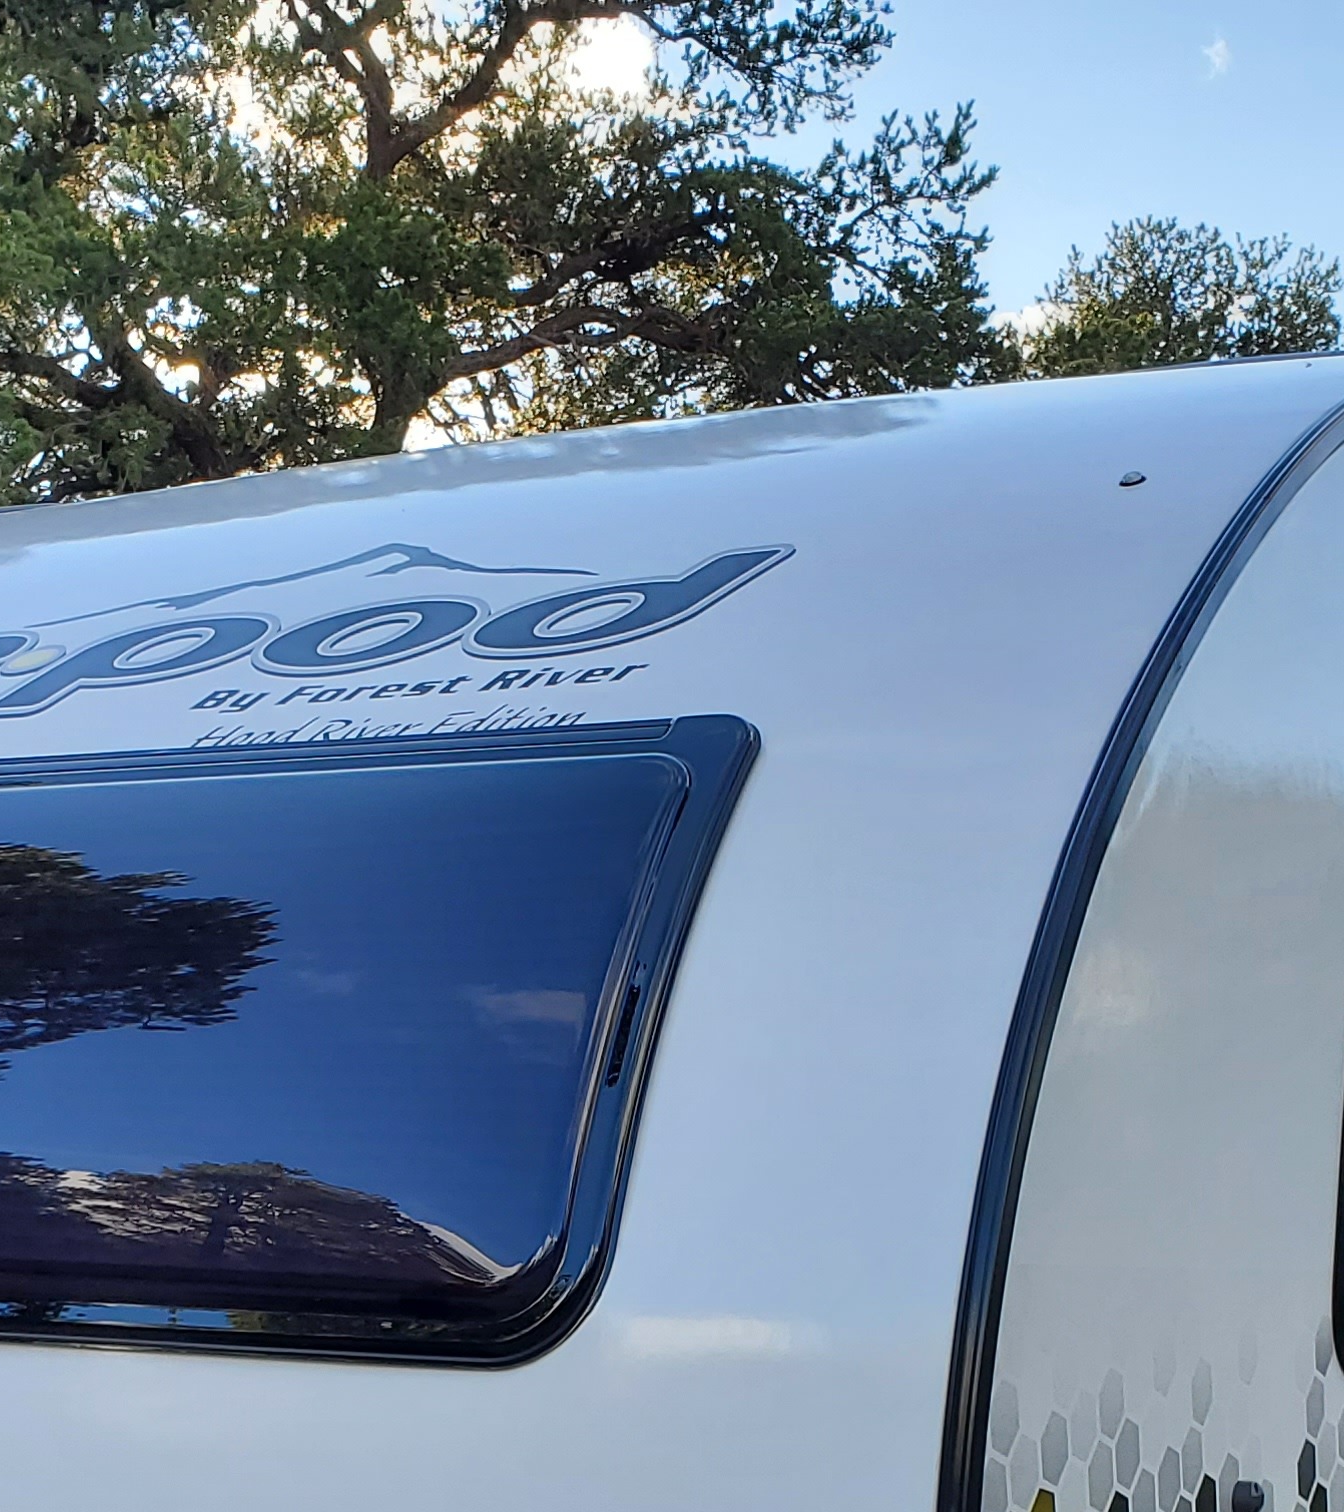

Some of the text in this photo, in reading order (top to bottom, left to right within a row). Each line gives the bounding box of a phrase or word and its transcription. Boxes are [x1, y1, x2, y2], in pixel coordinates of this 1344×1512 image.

[189, 663, 650, 714] By Forest River
[191, 703, 588, 748] Hood River Edition
